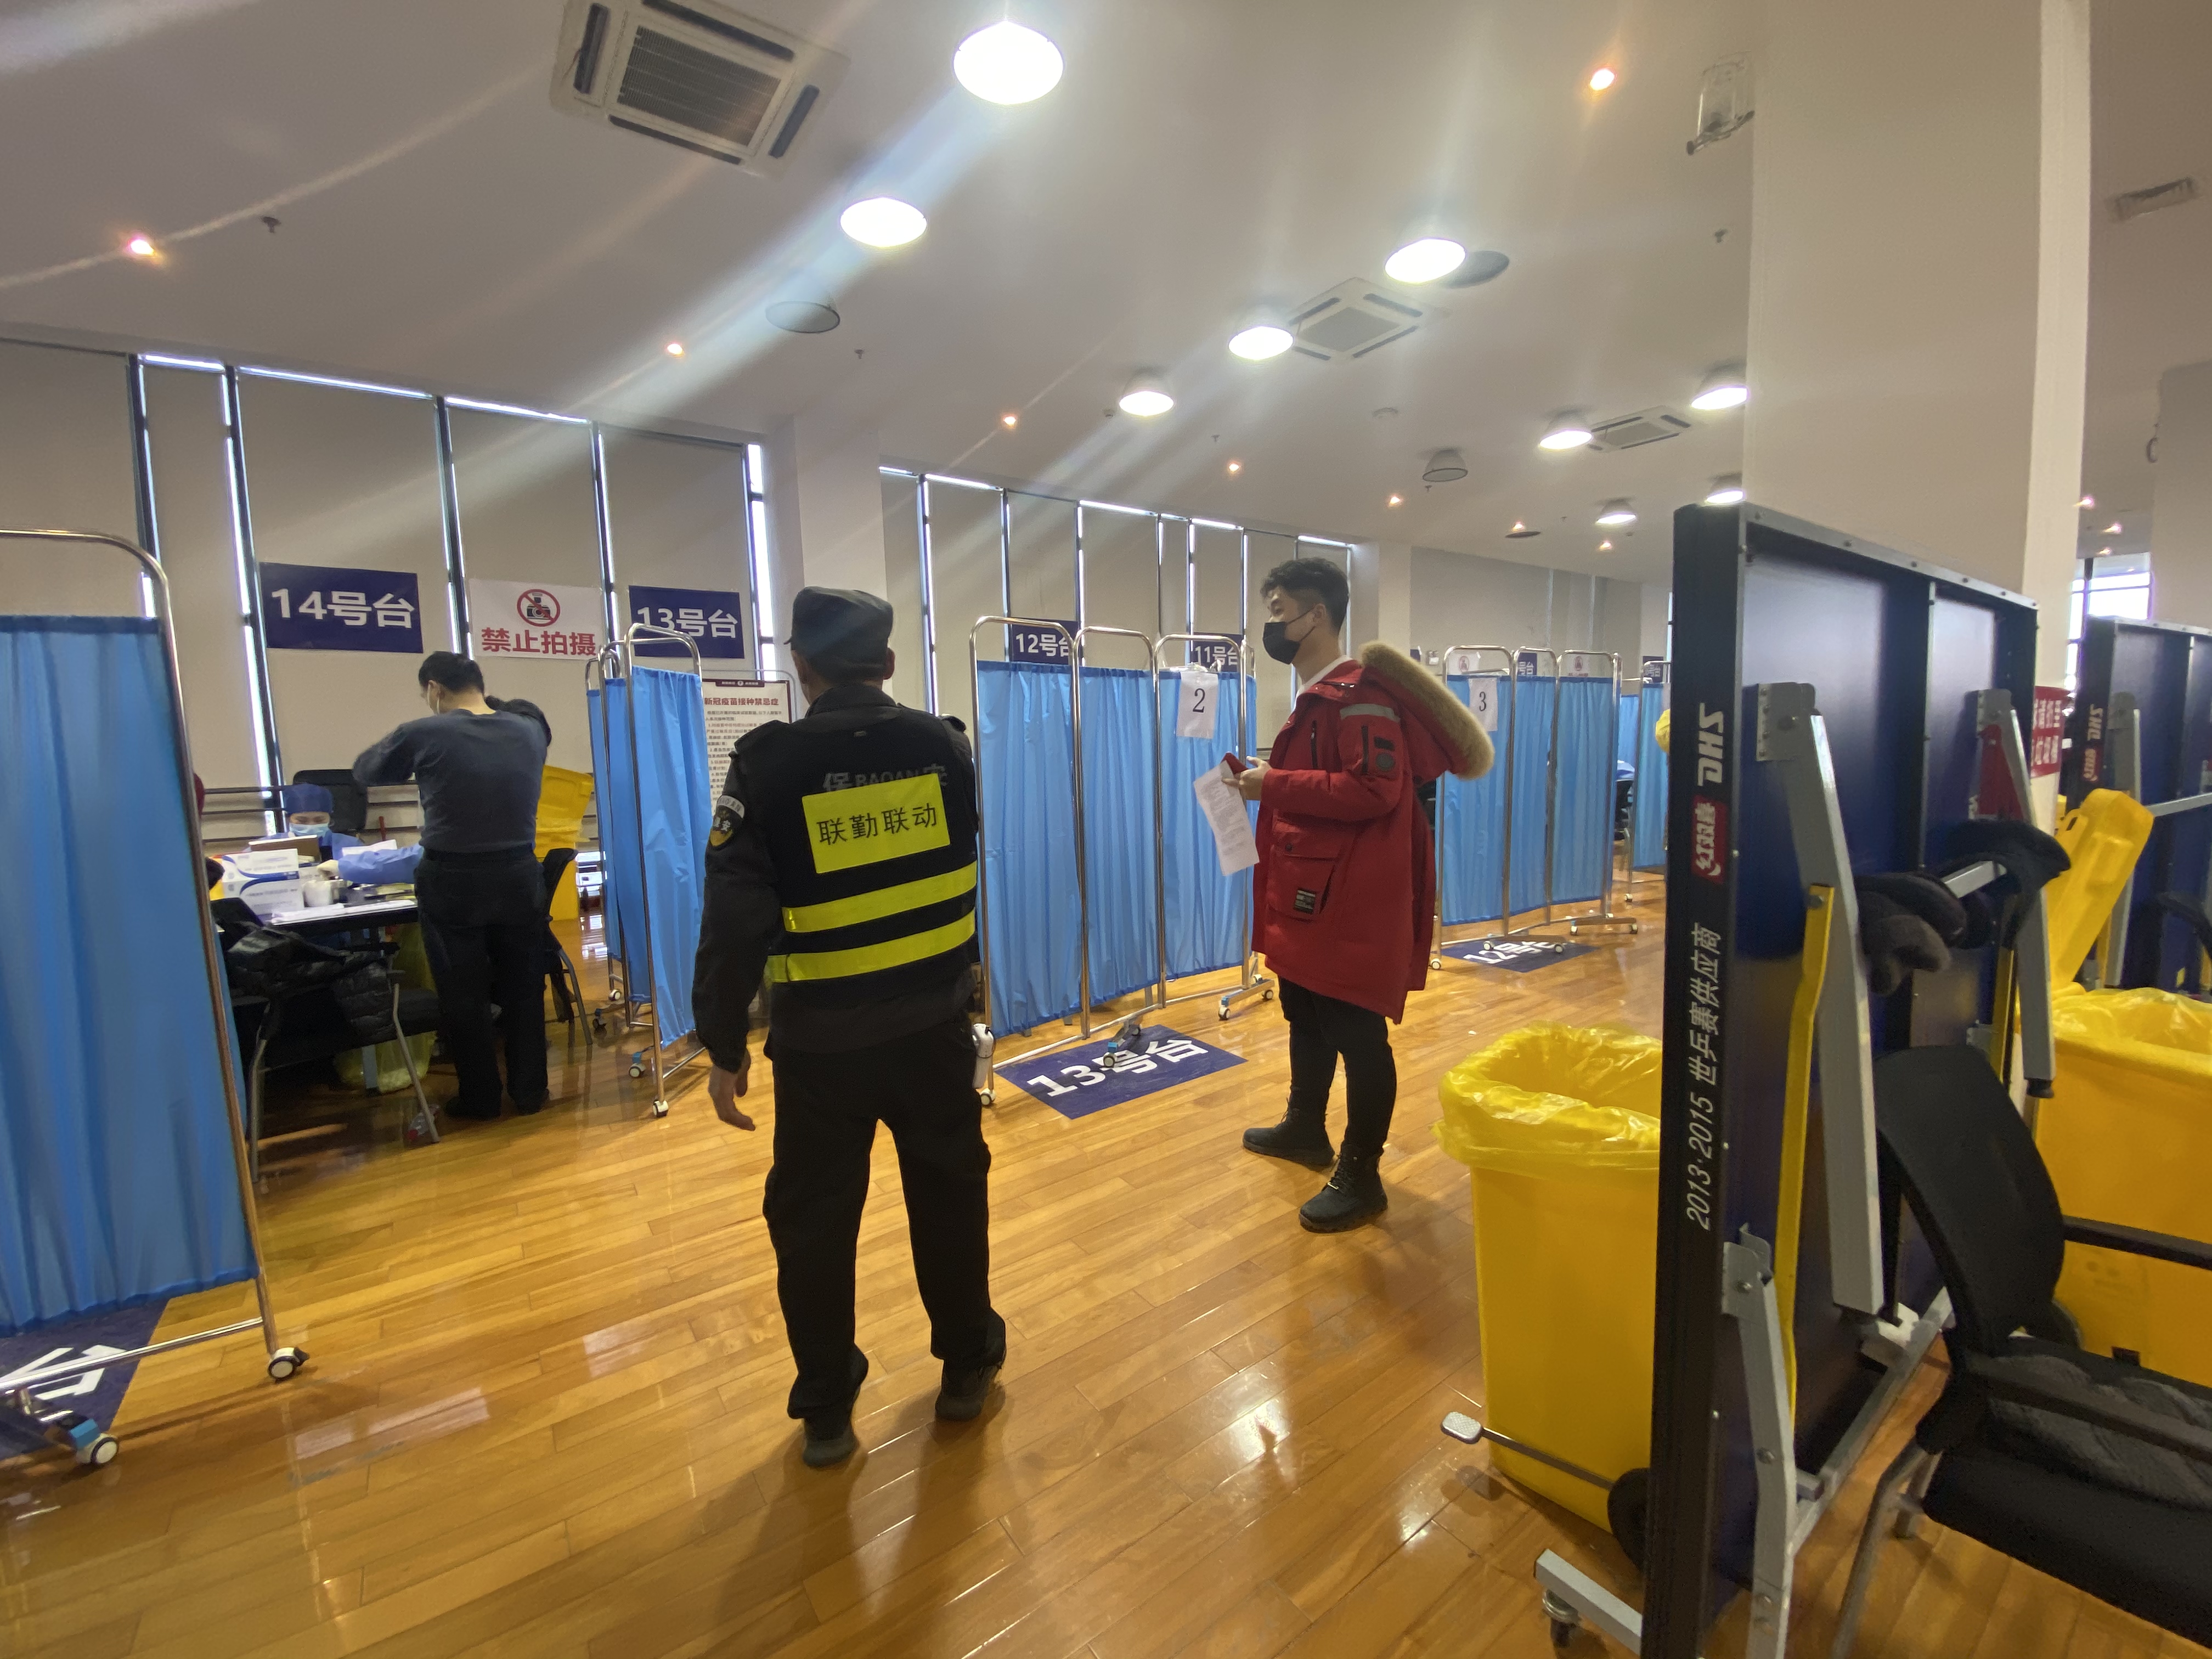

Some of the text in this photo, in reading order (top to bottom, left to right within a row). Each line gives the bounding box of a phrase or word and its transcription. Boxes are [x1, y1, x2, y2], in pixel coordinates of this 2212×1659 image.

[271, 588, 415, 628] 14号台
[637, 607, 738, 639] 13号台
[481, 627, 596, 656] 禁止拍摄
[704, 697, 779, 706] 新冠疫苗接种禁忌症
[1193, 688, 1205, 713] 2
[1479, 691, 1487, 712] 3
[1697, 702, 1724, 786] DHS
[816, 803, 938, 845] 联勤联动
[1688, 922, 1720, 1086] 世乒赛供应商
[1027, 1039, 1209, 1097] 13号台
